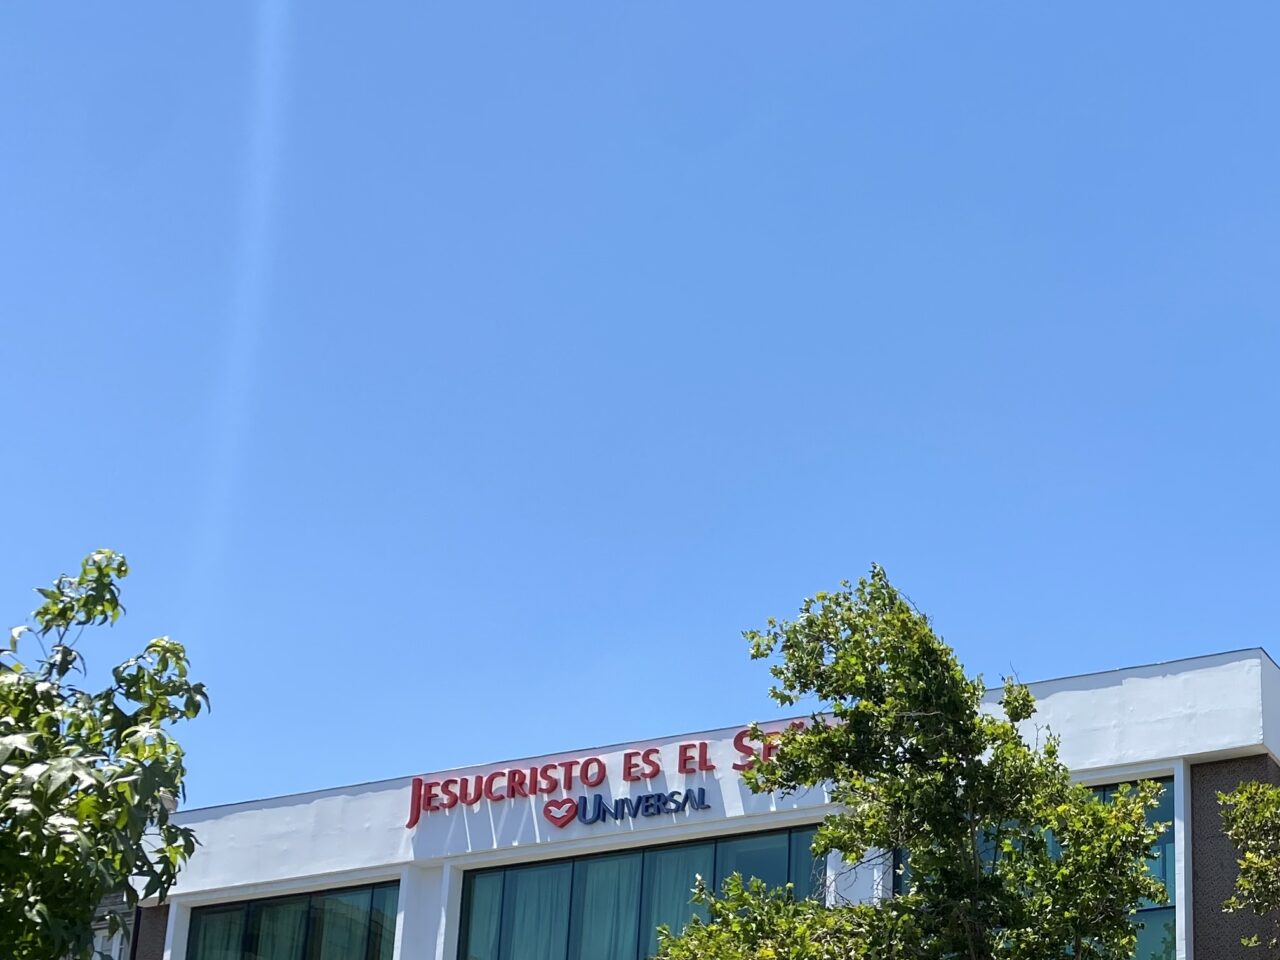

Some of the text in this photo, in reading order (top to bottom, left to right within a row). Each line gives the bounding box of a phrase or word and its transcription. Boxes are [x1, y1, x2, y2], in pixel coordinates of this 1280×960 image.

[406, 742, 716, 829] JESUCRISTO ES EL
[577, 788, 711, 824] UNIVERSAL
